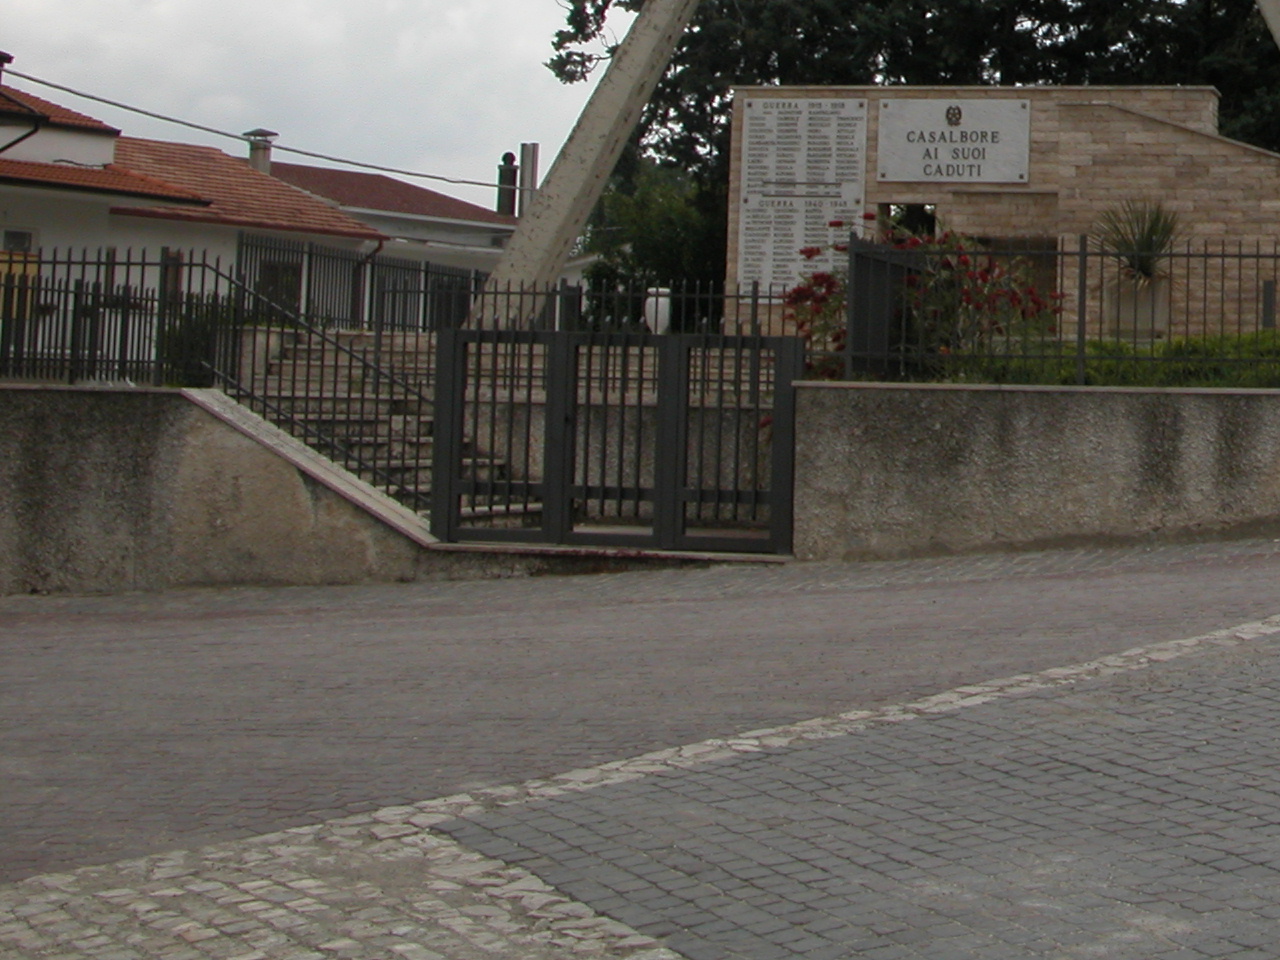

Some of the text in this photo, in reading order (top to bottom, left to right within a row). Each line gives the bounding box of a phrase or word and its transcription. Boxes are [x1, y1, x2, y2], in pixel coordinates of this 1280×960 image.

[906, 130, 1000, 144] CASALBORE
[922, 147, 986, 160] AI SUOI
[923, 164, 982, 177] CADUTI
[758, 200, 794, 208] GUERRA
